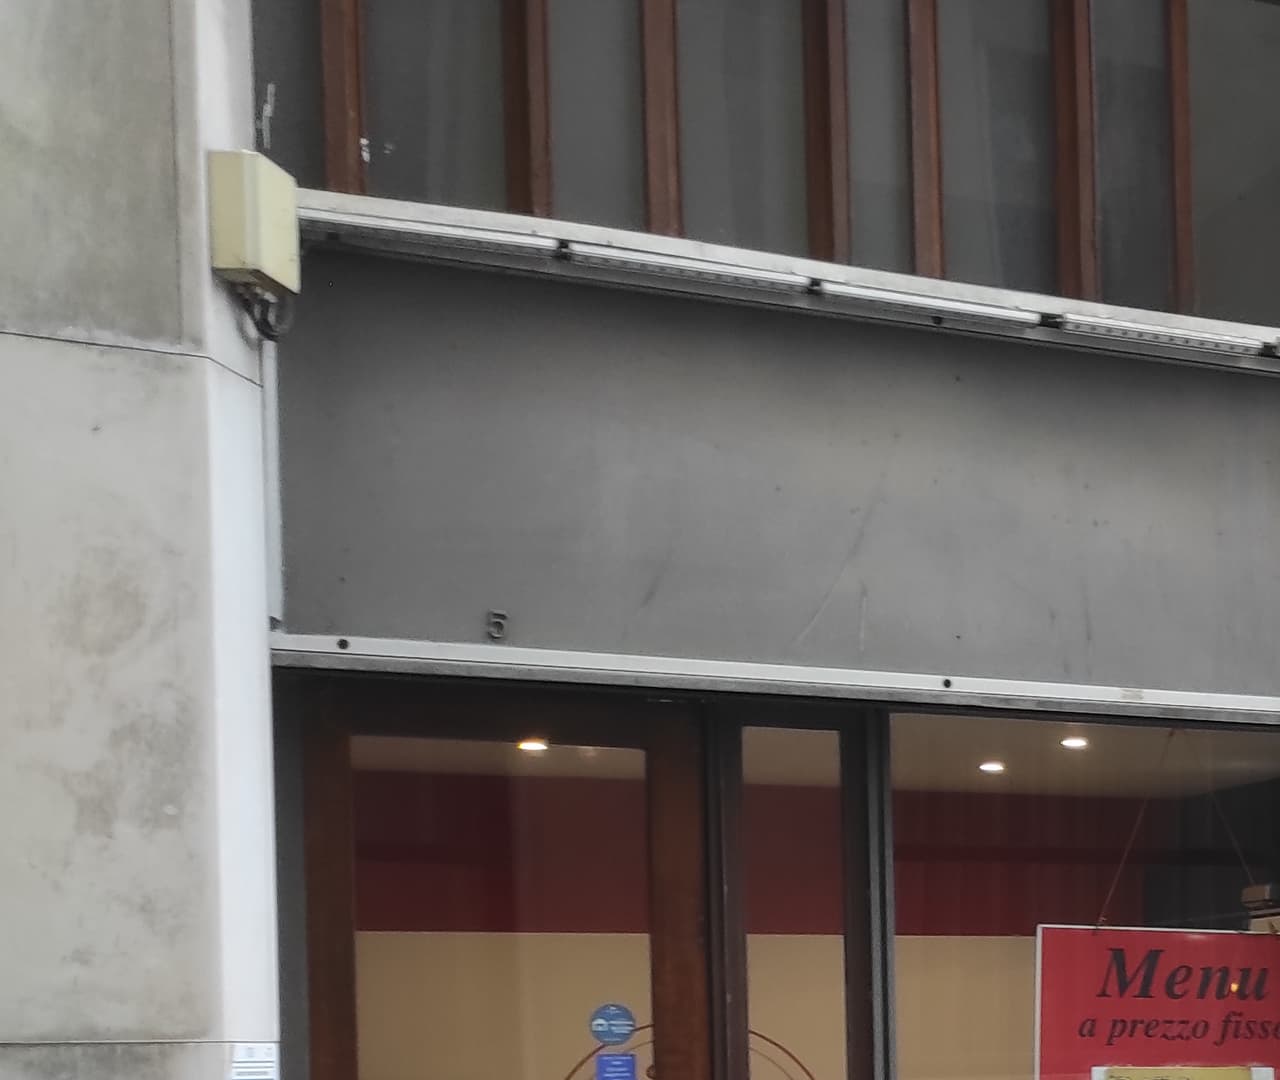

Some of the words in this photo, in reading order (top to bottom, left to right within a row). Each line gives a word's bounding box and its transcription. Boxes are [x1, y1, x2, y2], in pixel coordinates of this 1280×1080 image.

[486, 608, 508, 640] 5
[1096, 947, 1268, 1001] Menu
[1078, 1015, 1097, 1039] a
[1105, 1015, 1209, 1046] prezzo
